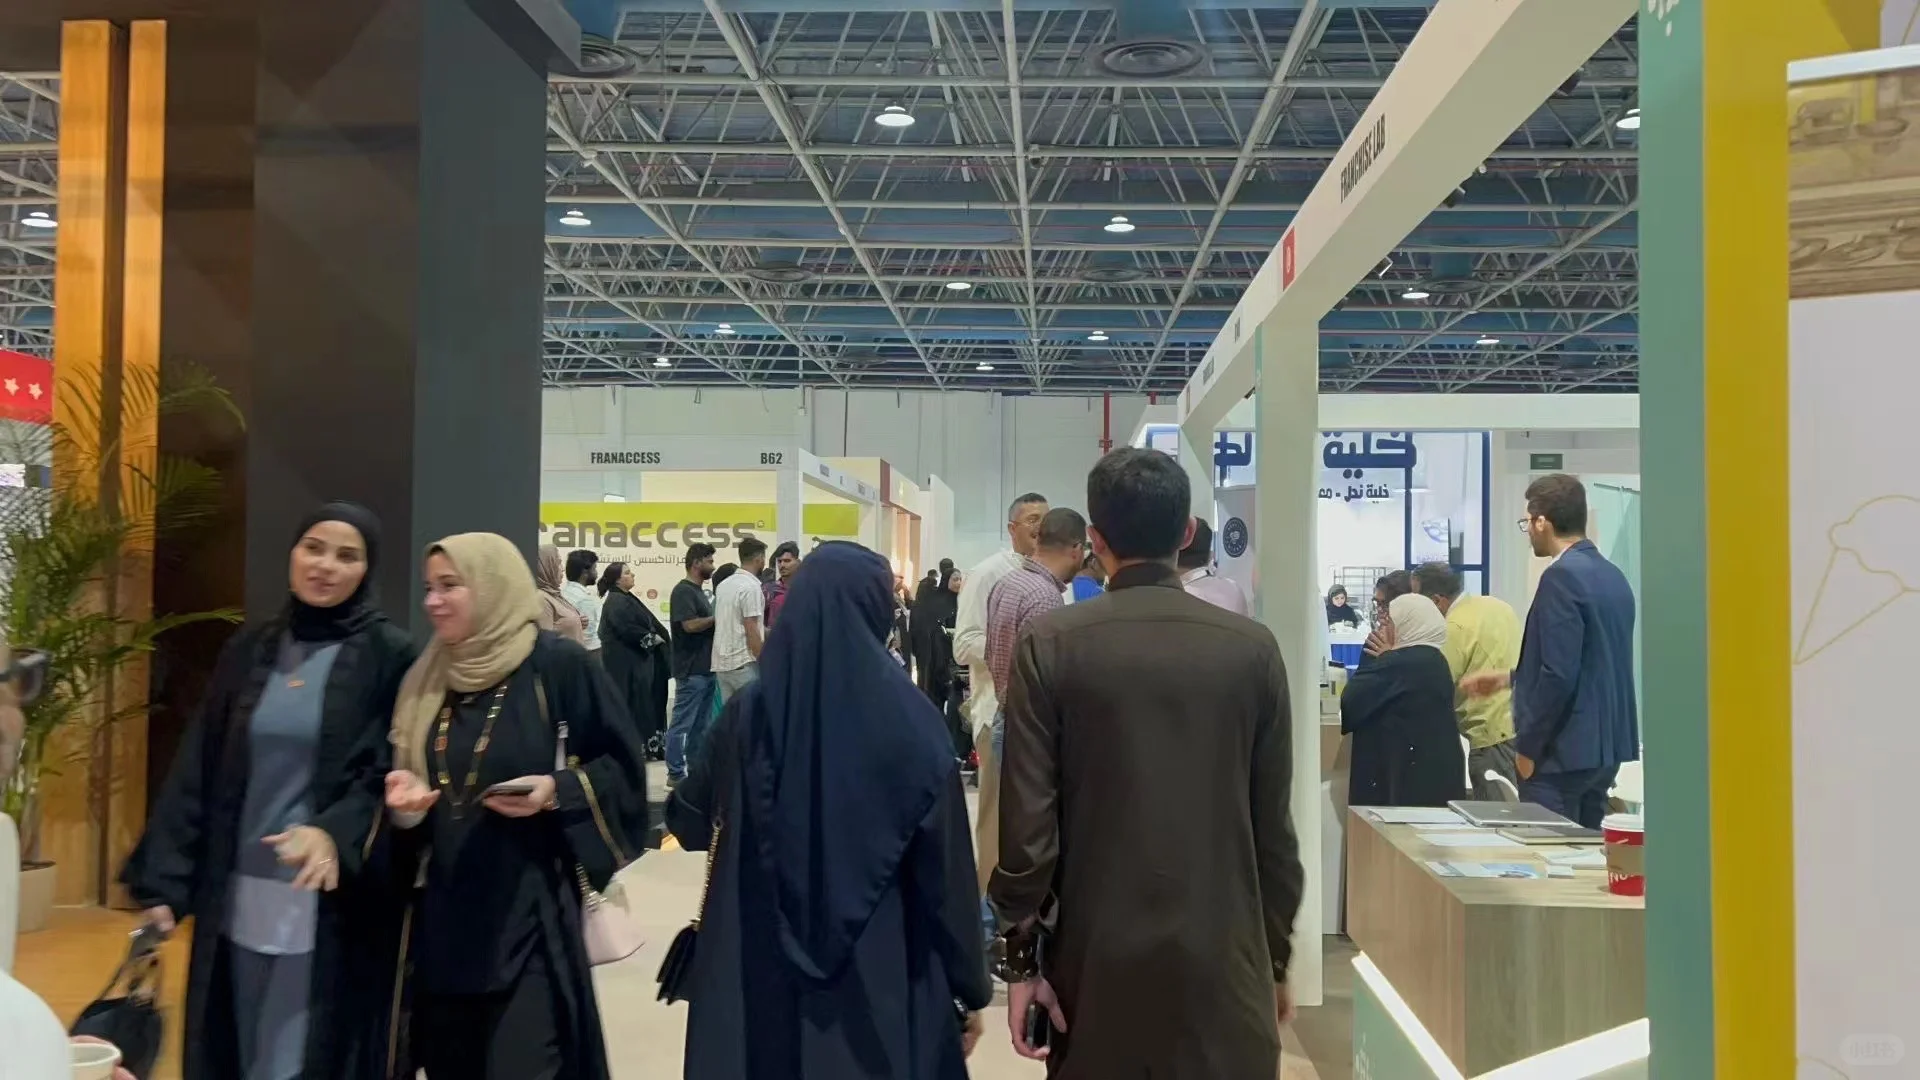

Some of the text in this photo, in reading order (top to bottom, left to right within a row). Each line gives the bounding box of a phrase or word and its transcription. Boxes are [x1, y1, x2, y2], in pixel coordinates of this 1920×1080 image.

[1341, 130, 1372, 204] FRANCHISE
[591, 452, 782, 465] FRANACCESS B62
[1344, 483, 1364, 502] نحل
[1366, 483, 1390, 503] خلية
[539, 521, 757, 548] anaccess
